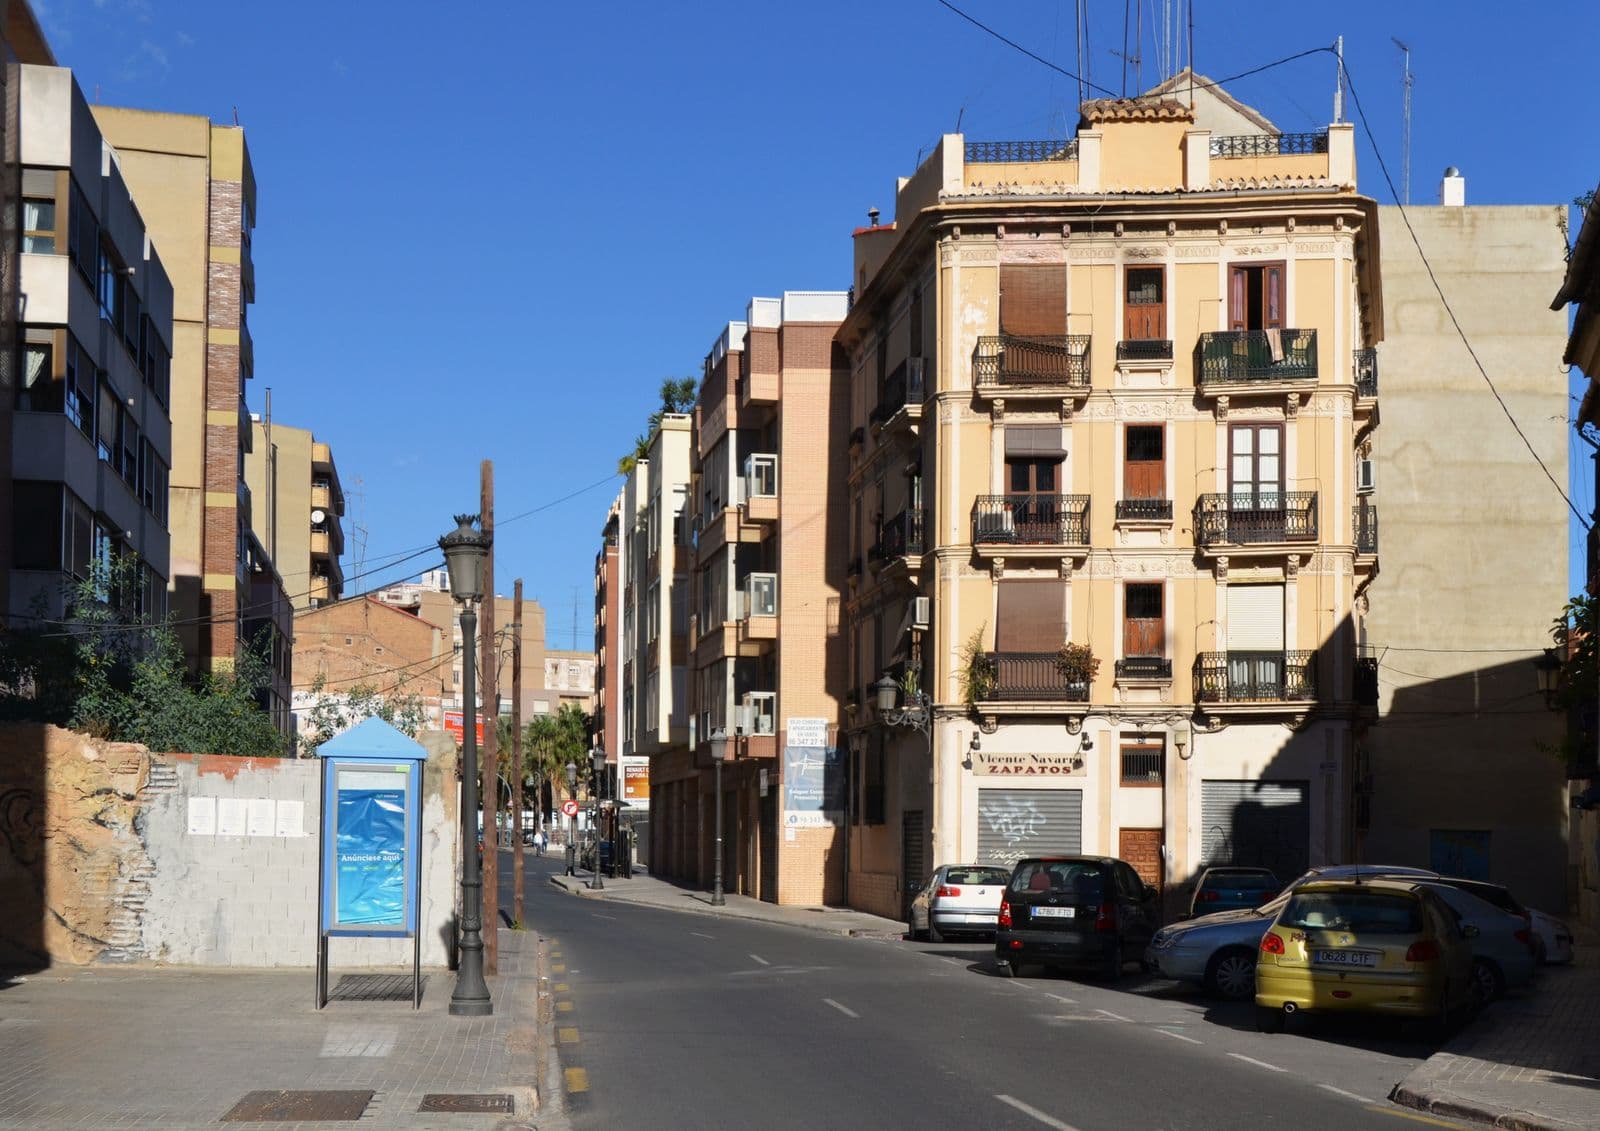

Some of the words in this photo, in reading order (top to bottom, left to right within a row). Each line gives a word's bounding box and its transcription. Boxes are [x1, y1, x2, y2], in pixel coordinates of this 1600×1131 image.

[979, 754, 1026, 764] Vicente
[1031, 754, 1083, 765] Navarr
[989, 765, 1072, 774] ZAPATOS
[341, 853, 382, 862] Anúnciese
[1322, 951, 1346, 961] 0628
[1352, 954, 1369, 964] CTF
